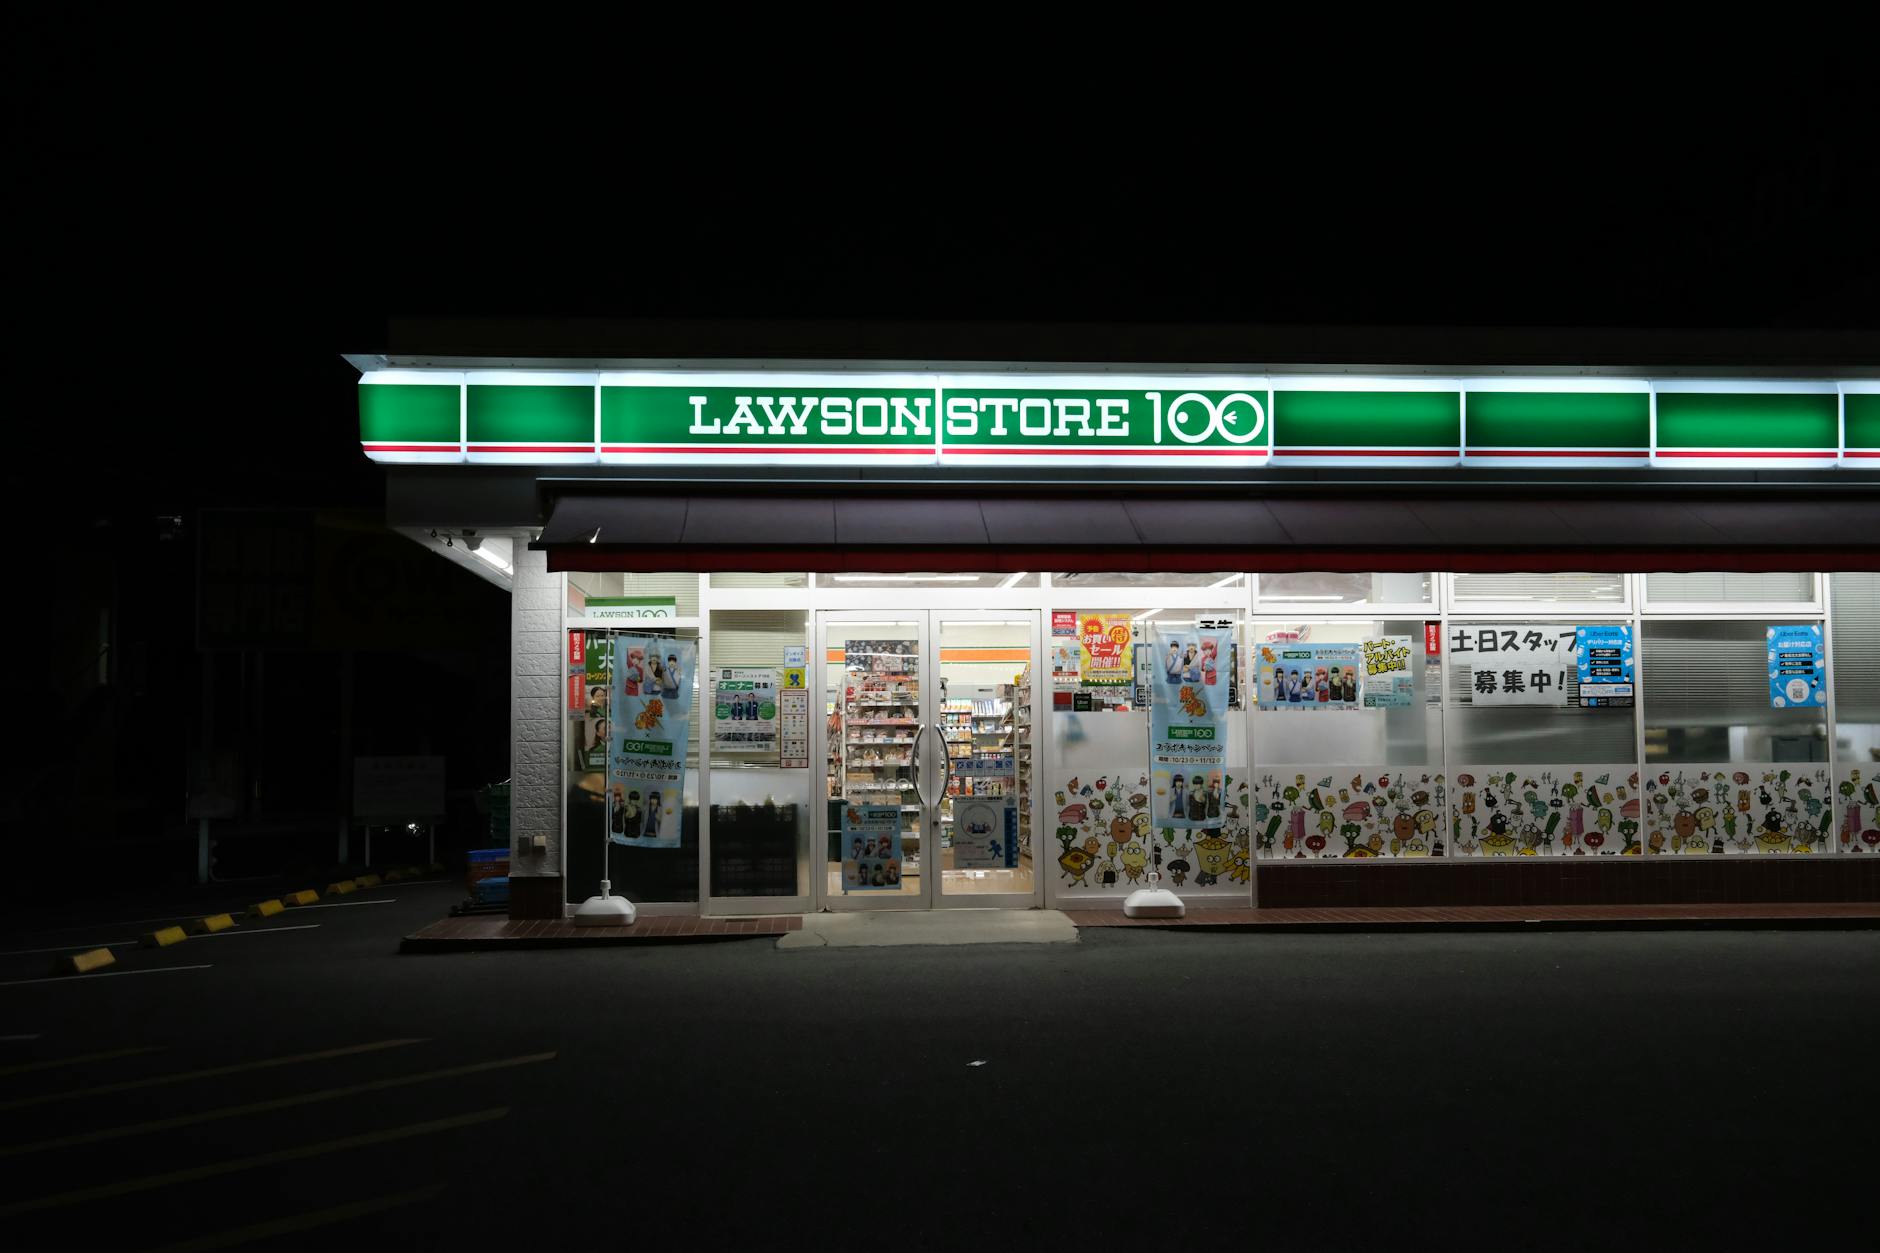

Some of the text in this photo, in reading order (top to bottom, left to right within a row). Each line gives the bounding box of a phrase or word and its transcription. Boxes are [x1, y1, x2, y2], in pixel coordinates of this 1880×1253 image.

[689, 391, 1265, 444] LAWSON STORE 100
[1091, 644, 1123, 656] セール
[1365, 646, 1411, 664] アルバイト
[1474, 669, 1566, 694] 募集中!
